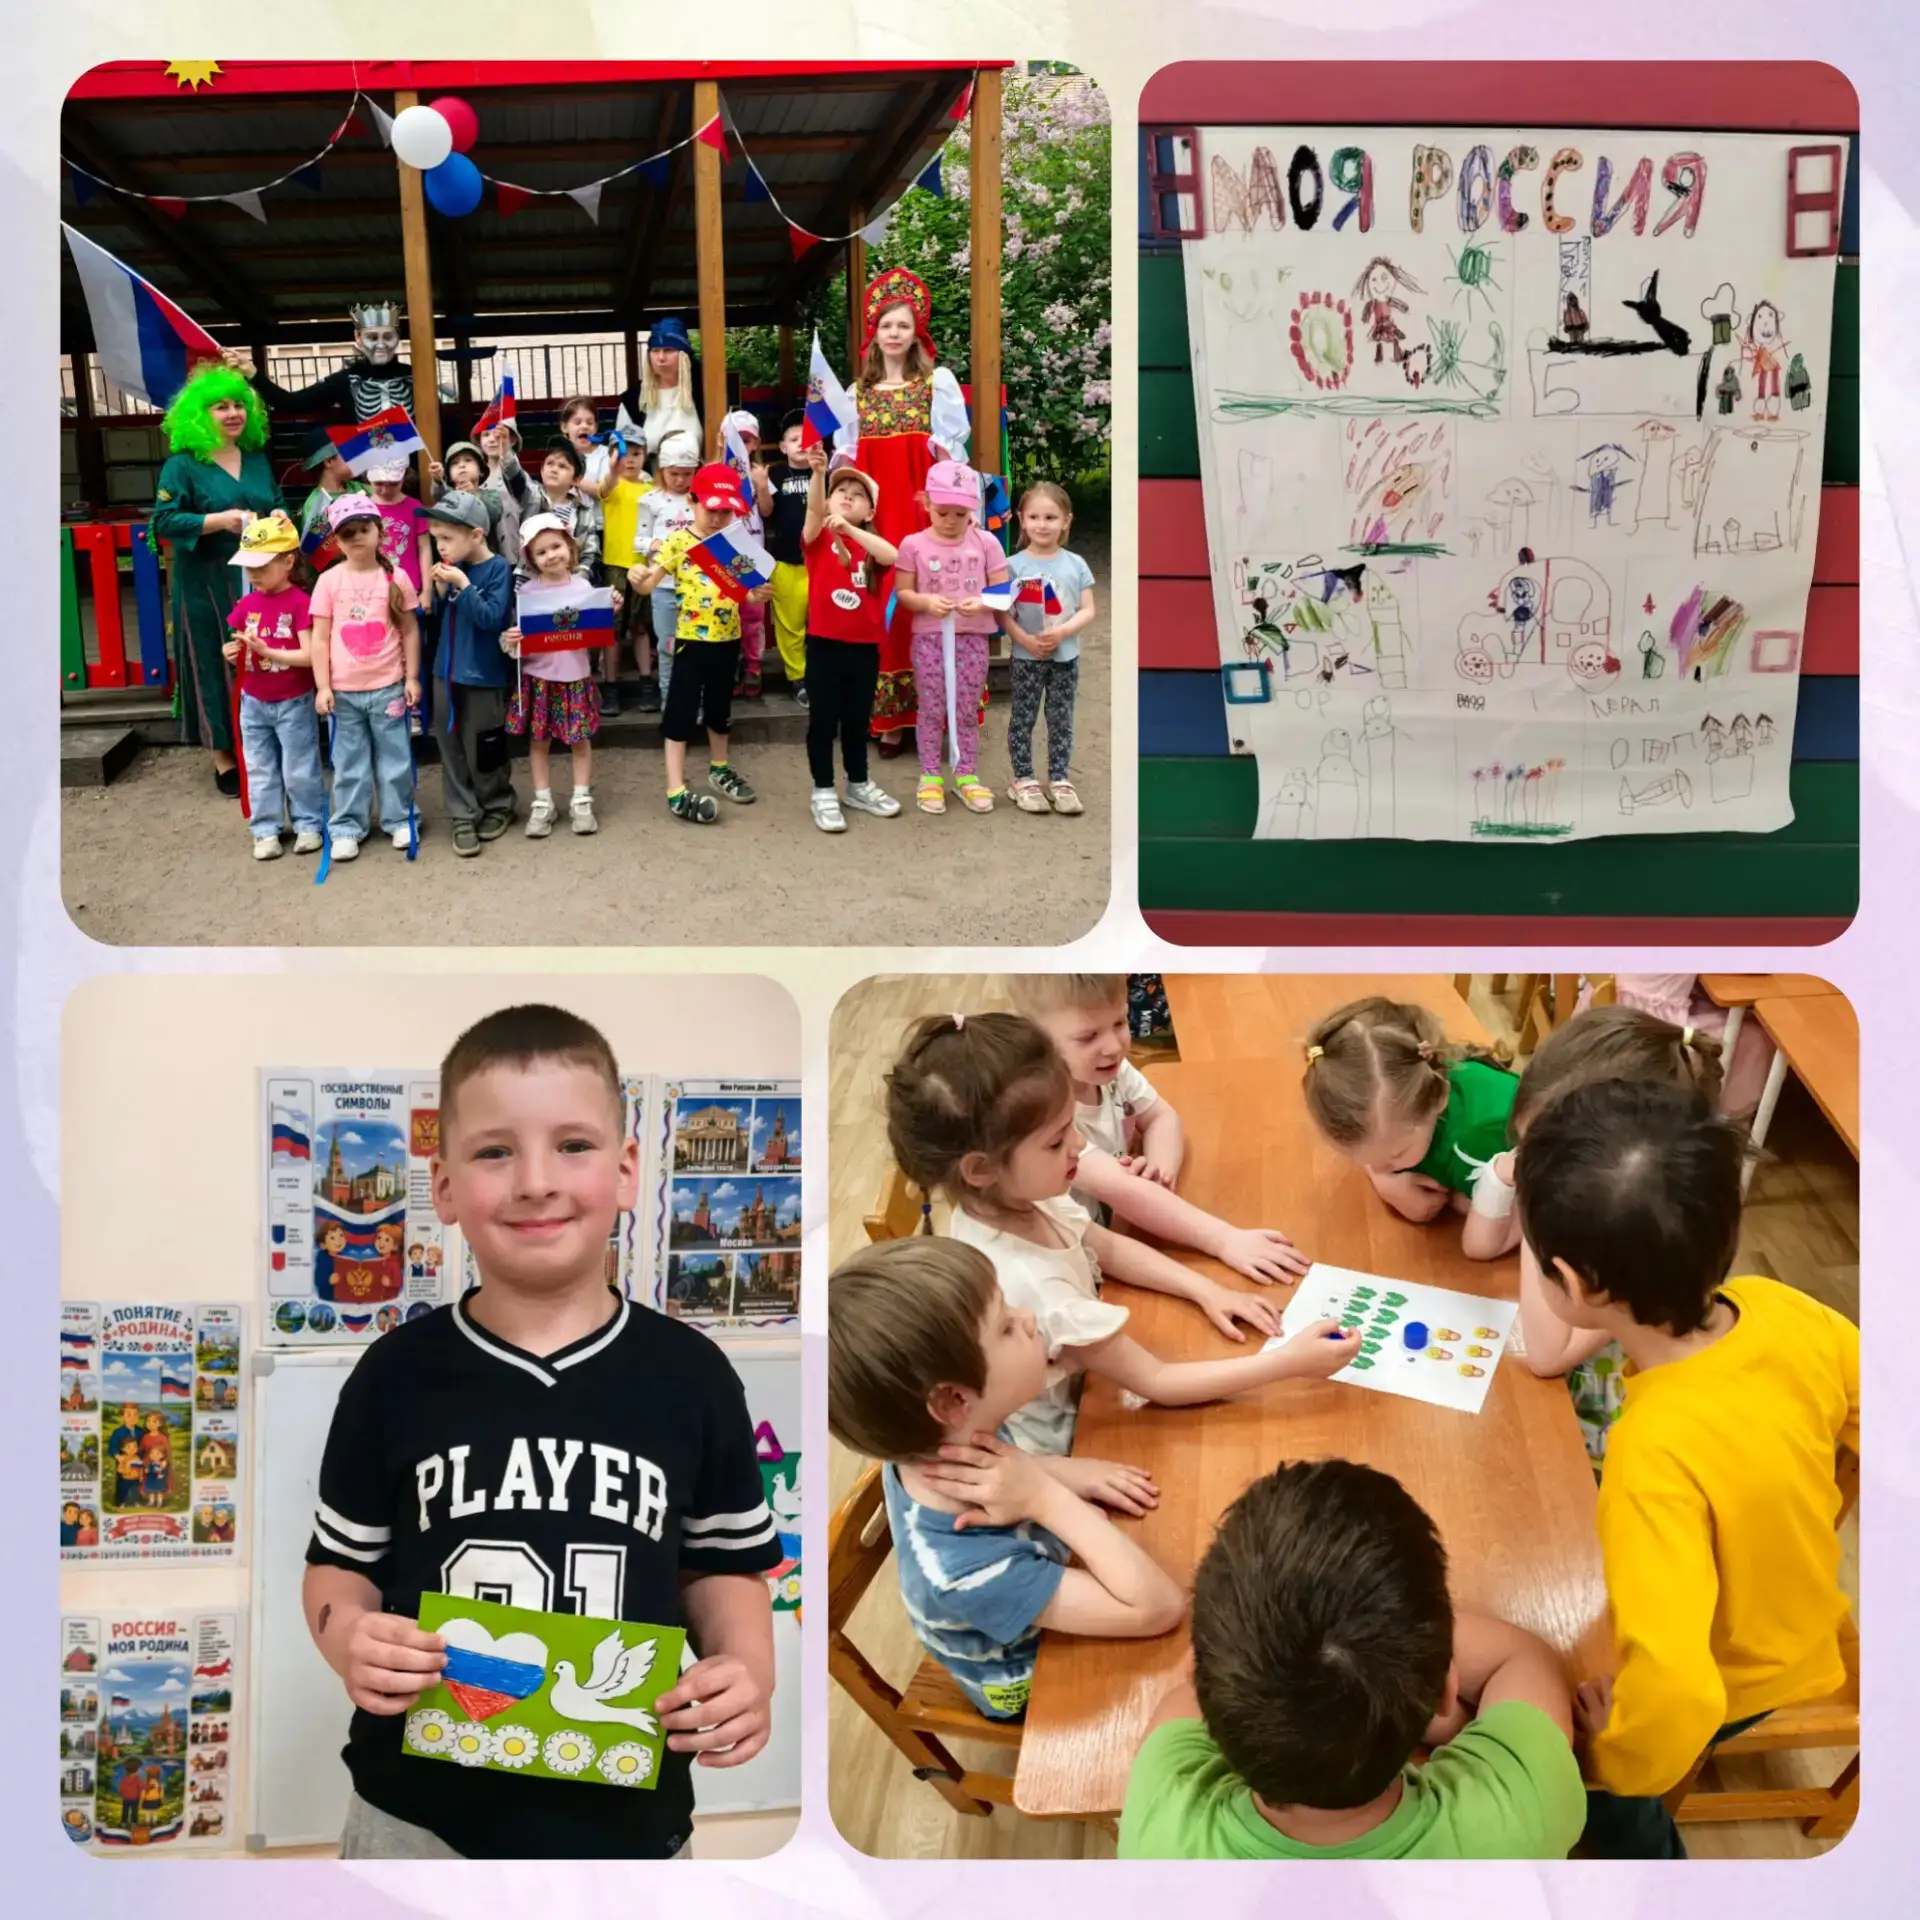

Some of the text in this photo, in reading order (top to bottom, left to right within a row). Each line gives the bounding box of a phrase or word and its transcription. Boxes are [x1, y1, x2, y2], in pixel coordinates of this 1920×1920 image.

[1211, 144, 1707, 239] МОЯ РОССИЯ
[320, 1083, 404, 1095] ГОСУДАРСТВЕННЫЕ
[335, 1097, 391, 1110] СИМВОЛЫ
[720, 1238, 753, 1247] Москва
[113, 1305, 183, 1323] ПОНЯТИЕ
[416, 1437, 668, 1542] PLAYER
[112, 1620, 177, 1639] РОССИЯ
[108, 1639, 189, 1654] МОЯ РОДИНА
